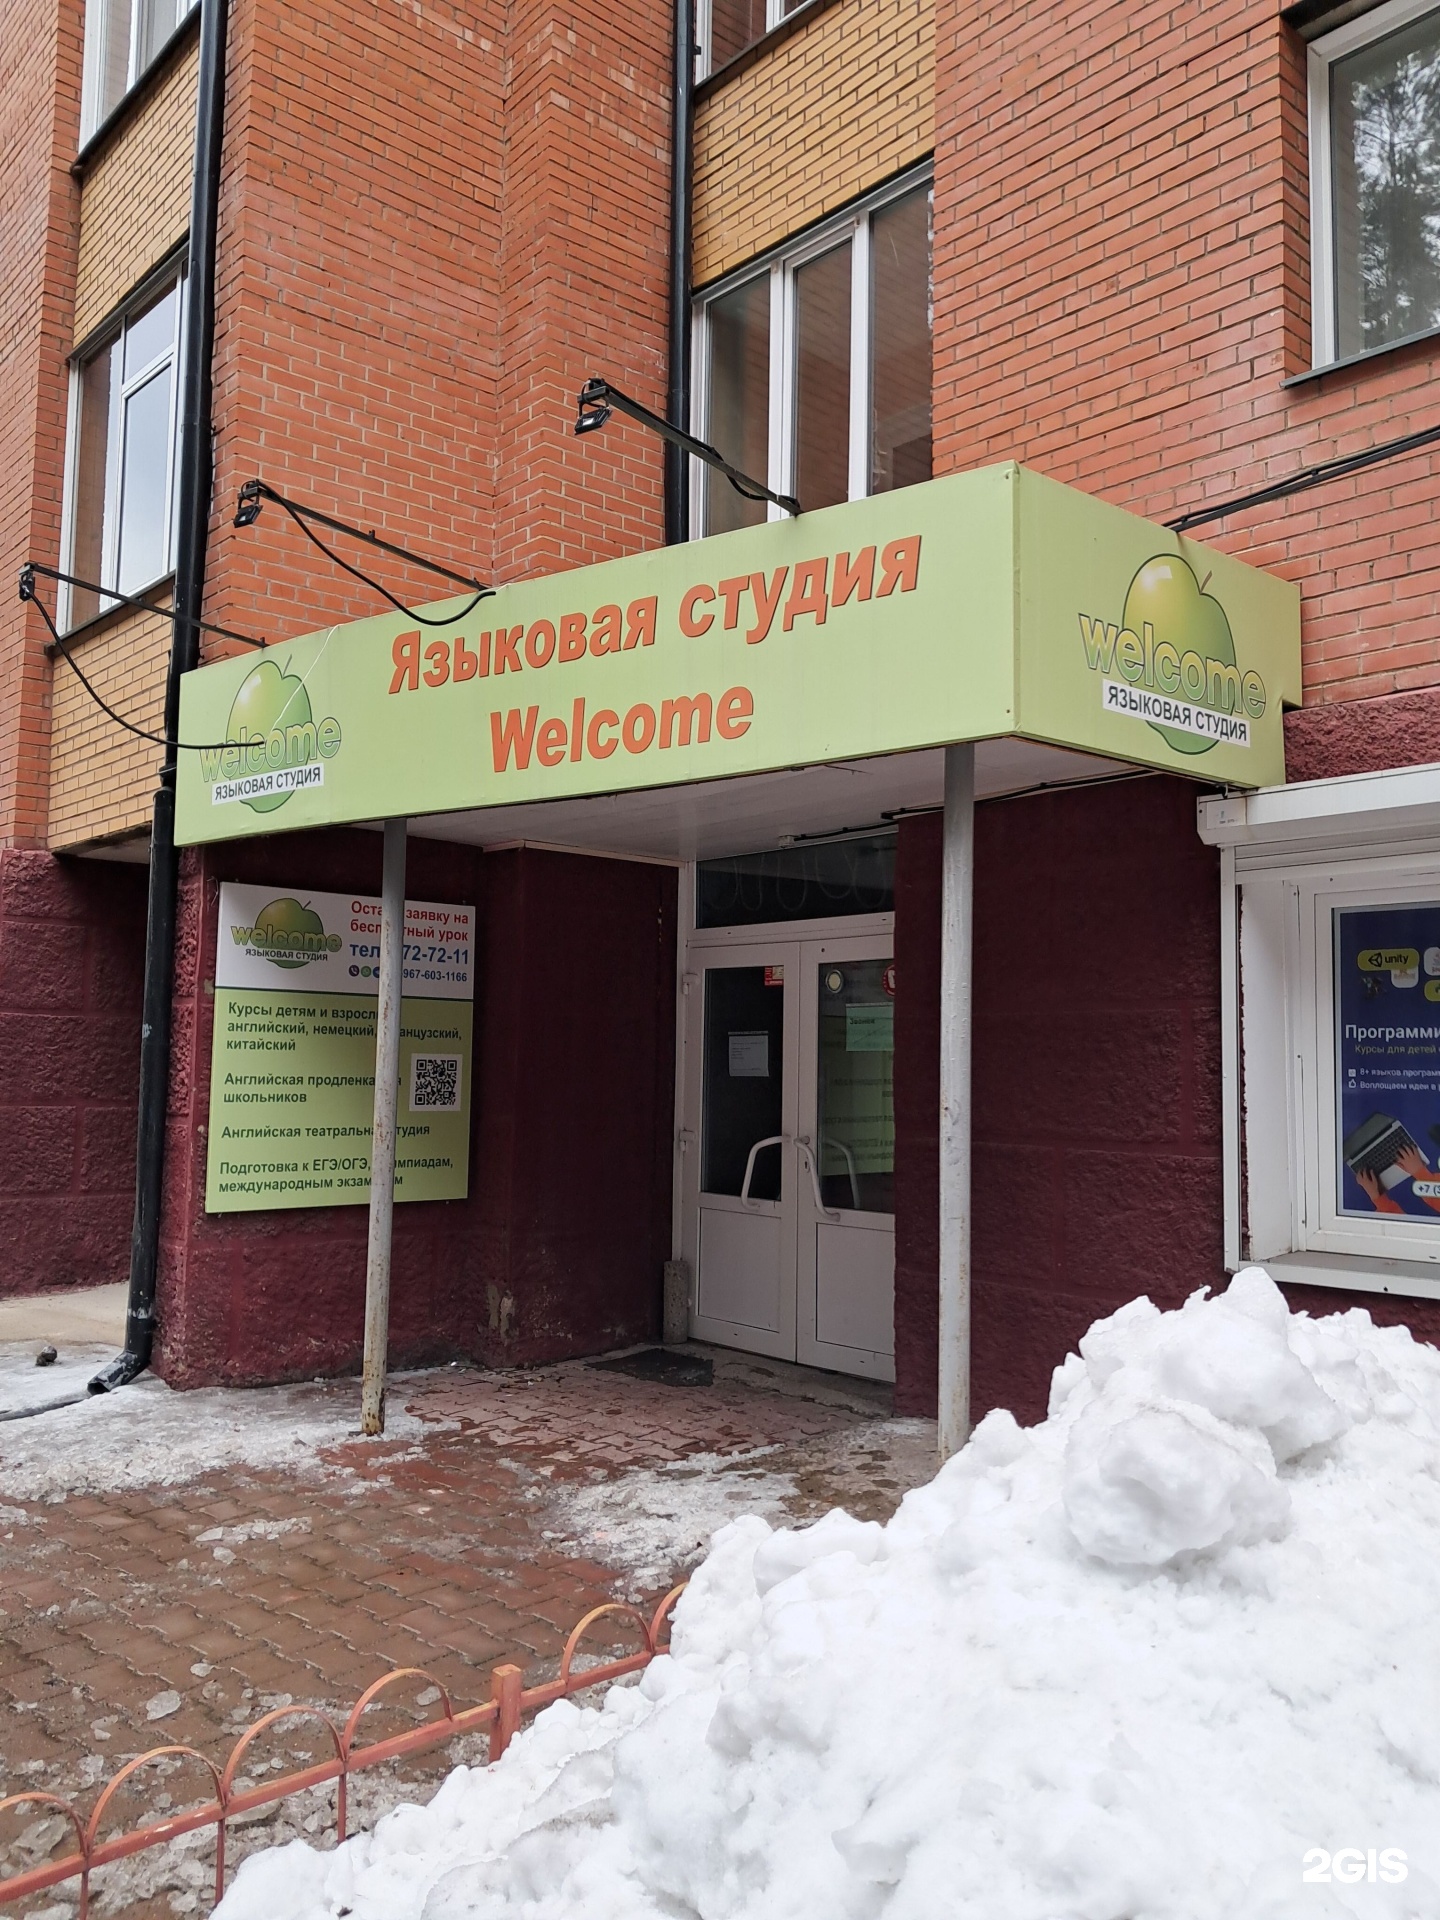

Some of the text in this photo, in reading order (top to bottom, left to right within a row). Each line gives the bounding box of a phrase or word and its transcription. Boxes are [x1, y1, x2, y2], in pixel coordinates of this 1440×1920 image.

[388, 534, 922, 694] Языковая студия
[1078, 613, 1267, 719] welcome
[1108, 685, 1247, 742] ЯЗЫКОВАЯ СТУДИЯ
[490, 686, 754, 773] Welcome
[198, 715, 342, 783] welcome
[214, 766, 322, 801] ЯЗЫКОВАЯ СТУДИЯ
[351, 901, 468, 925] Оста заявку на
[231, 924, 342, 952] welcome
[350, 919, 468, 942] бесптный урок
[245, 948, 328, 961] ЯЗЫКОВАЯ СТУДИЯ
[1385, 953, 1409, 965] unity
[229, 1002, 379, 1023] Курсы детям и взросл
[227, 1021, 463, 1041] английский, немецкий, анцузский,
[226, 1037, 296, 1051] китайский
[1355, 1044, 1437, 1055] Курсы для детей
[224, 1072, 376, 1089] Английская продленка
[1360, 1067, 1369, 1076] 8+
[1371, 1069, 1402, 1077] языков
[223, 1091, 307, 1103] школьников
[221, 1124, 301, 1138] Английская
[396, 1124, 430, 1138] тудия
[220, 1158, 454, 1177] Подготовка к ЕГЭ/ОГЭ, импиадам,
[218, 1175, 403, 1195] международным экзамм
[1418, 1184, 1430, 1193] +7
